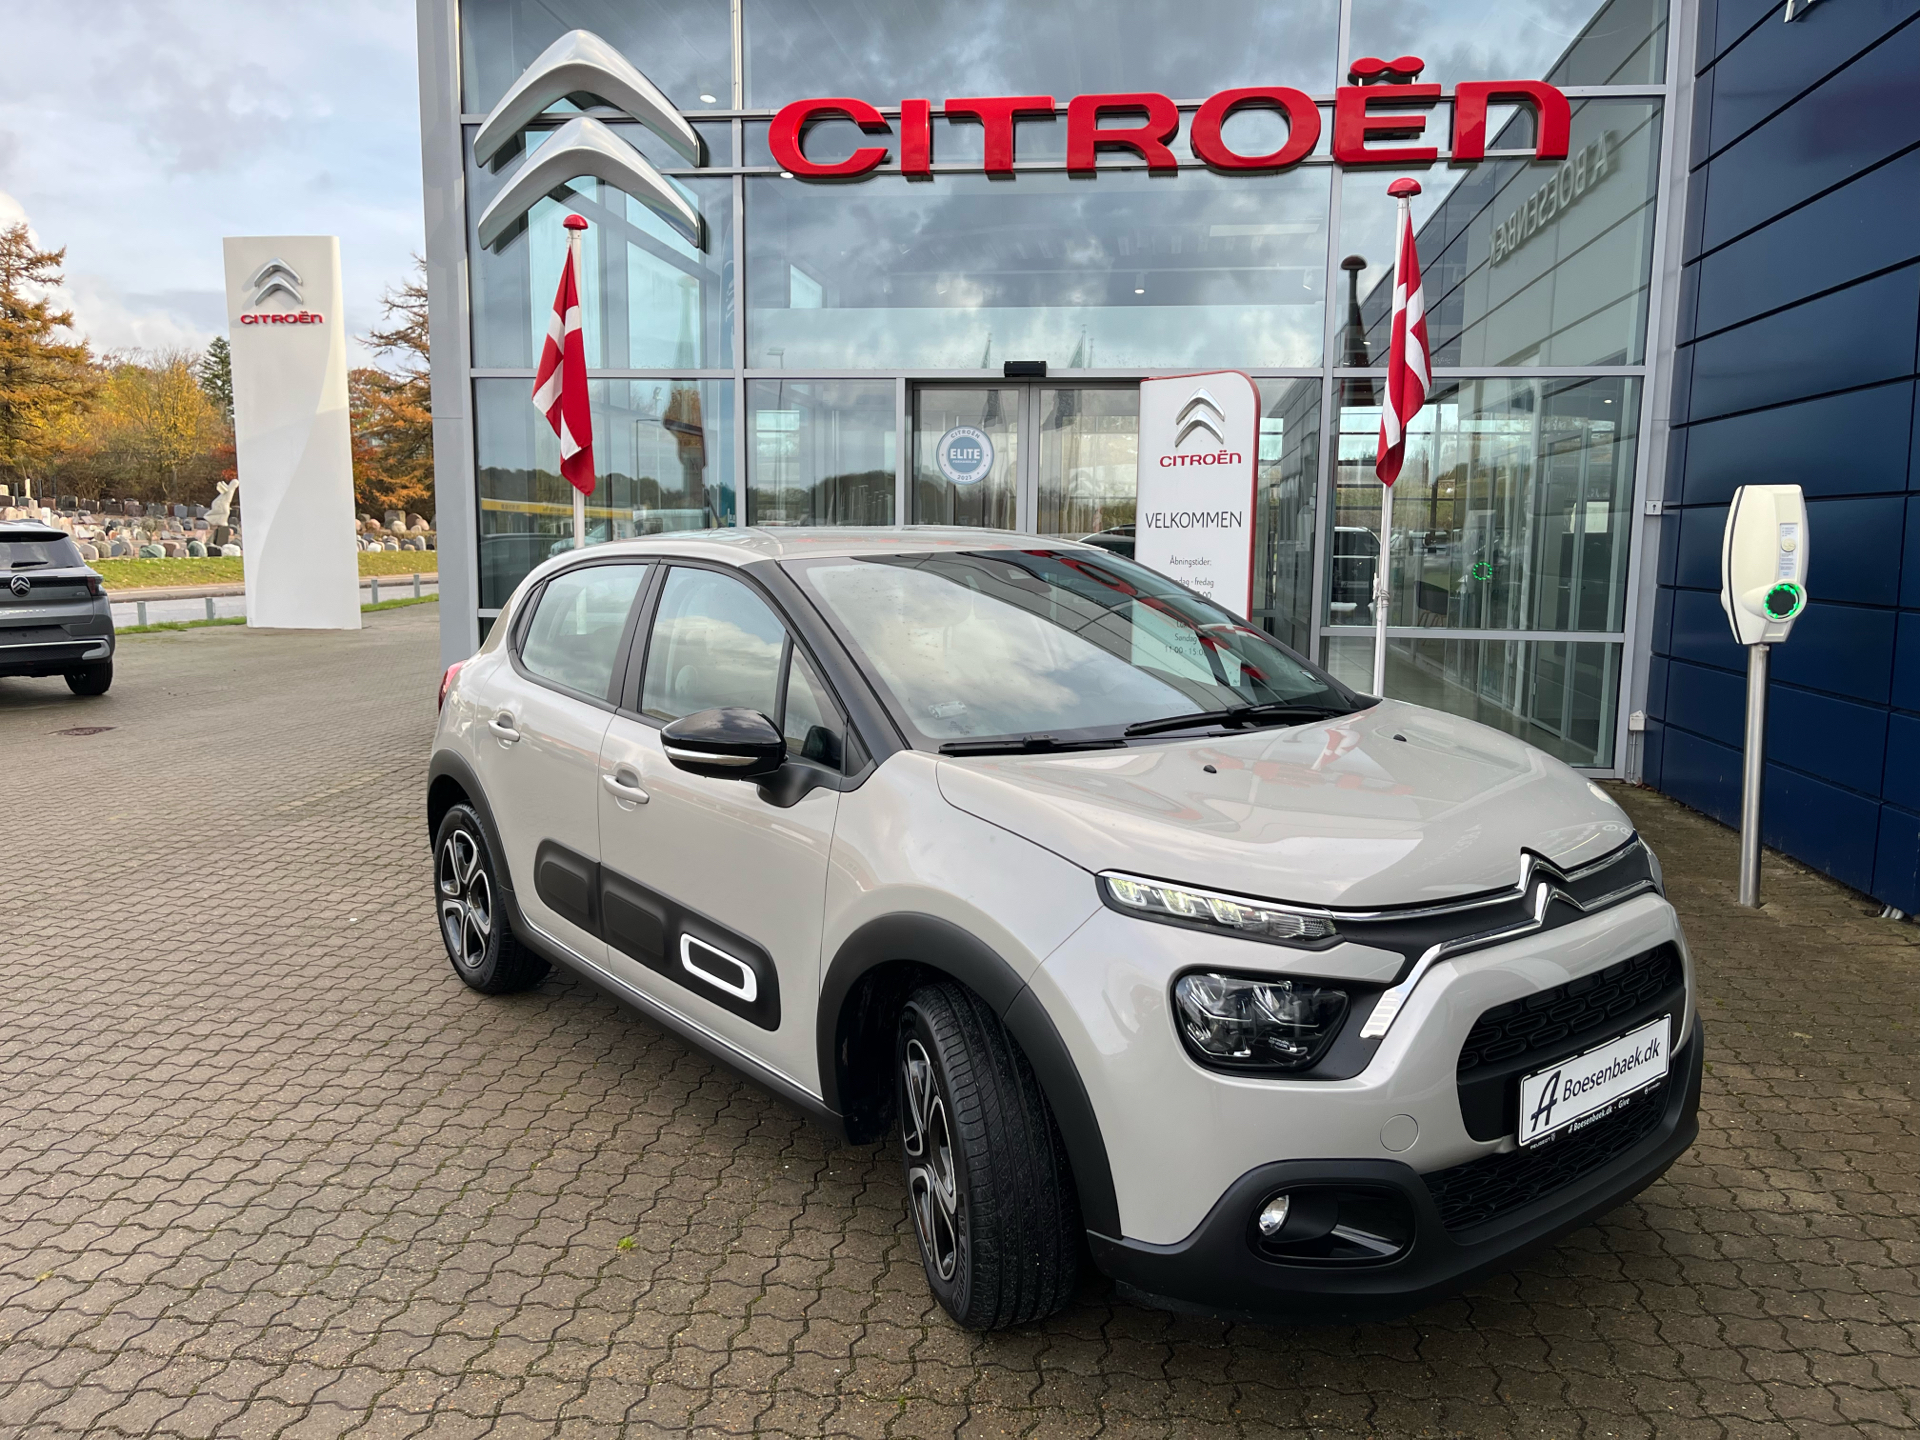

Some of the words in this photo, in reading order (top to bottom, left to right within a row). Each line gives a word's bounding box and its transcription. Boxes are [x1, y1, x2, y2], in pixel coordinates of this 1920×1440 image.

[768, 56, 1571, 179] CITROËN
[240, 311, 323, 325] CITROËN
[950, 429, 980, 439] CITROËN
[950, 448, 980, 459] ELITE
[1159, 450, 1242, 467] CITROËN
[1145, 511, 1242, 529] VELKOMMEN
[1169, 554, 1212, 568] Åbningstider:
[1194, 577, 1214, 588] fredag
[1189, 648, 1206, 656] 15:0
[1562, 1037, 1661, 1102] Boesenbaek.dk
